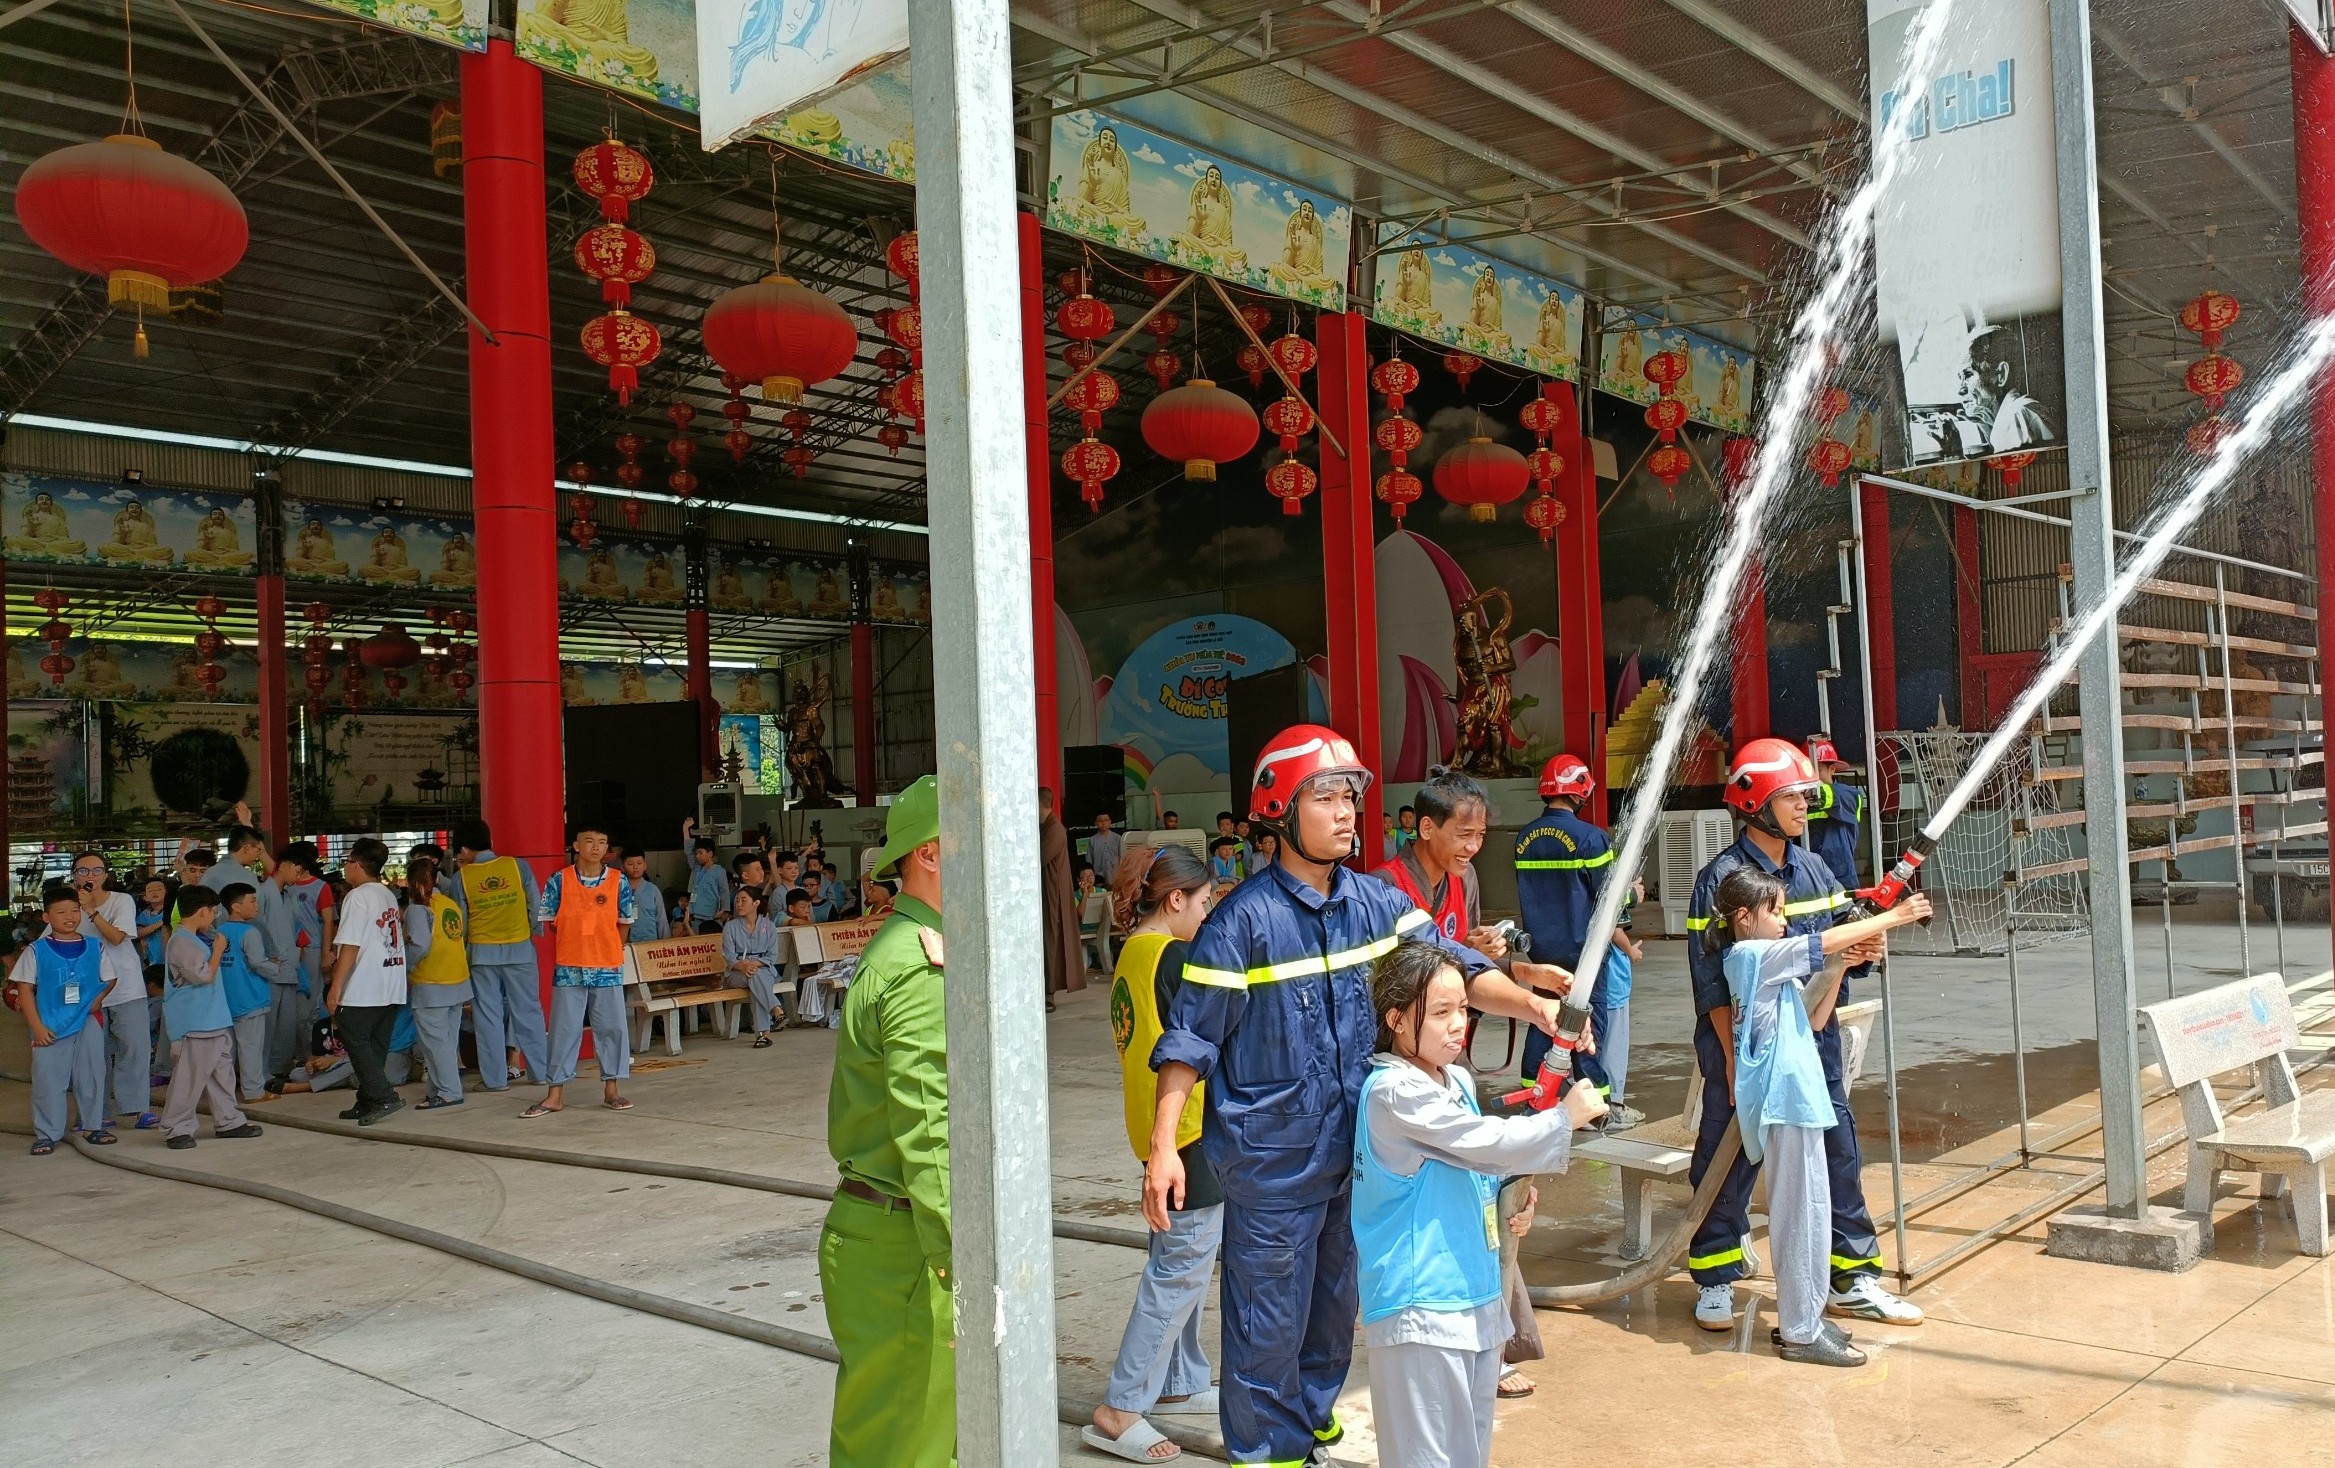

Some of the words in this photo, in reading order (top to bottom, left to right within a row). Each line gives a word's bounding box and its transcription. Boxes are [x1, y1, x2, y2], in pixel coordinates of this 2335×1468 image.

[1933, 58, 2014, 133] Cha!
[647, 947, 675, 960] THIÊN
[676, 945, 691, 957] ÂN
[691, 942, 717, 955] PHÚC
